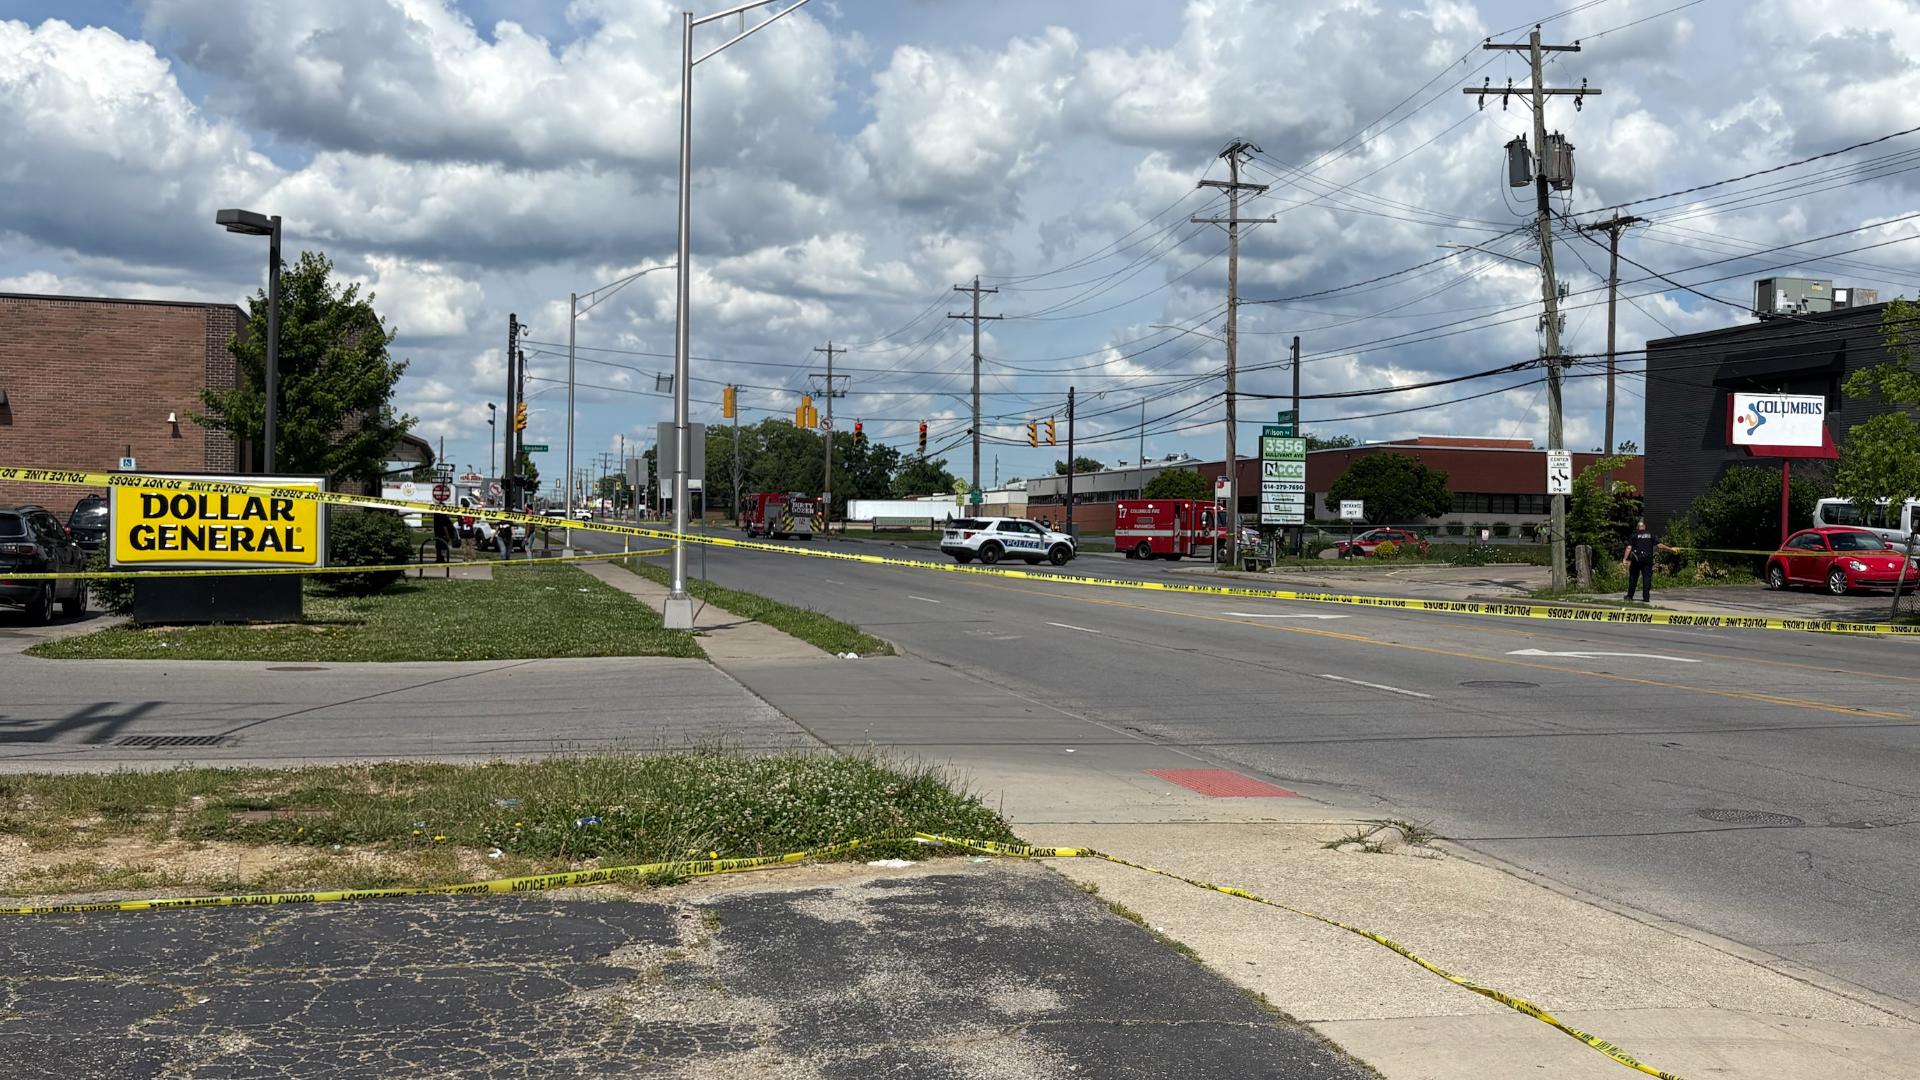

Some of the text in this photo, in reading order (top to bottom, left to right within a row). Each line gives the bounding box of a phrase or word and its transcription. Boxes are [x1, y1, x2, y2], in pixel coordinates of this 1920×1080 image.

[1756, 400, 1823, 414] COLUMBUS
[1265, 439, 1304, 452] 3556
[2, 468, 87, 483] POLICE LINE DO
[107, 475, 250, 495] POLICE LINE DO NOT CROSS
[270, 488, 302, 499] CROSS
[140, 492, 295, 522] DOLLAR
[428, 503, 562, 525] POLICE LINE DO NOT CROSS
[1119, 508, 1128, 519] 17
[129, 524, 305, 553] GENERAL
[1006, 539, 1037, 549] POLICE
[1423, 601, 1531, 616] POLICE LINE DO NOT CROSS
[1547, 608, 1653, 623] POLICE LINE DO NOT CROSS
[1668, 614, 1768, 628] POLICE LINE DO NOT CROSS
[1782, 619, 1805, 629] CROSS
[1806, 620, 1821, 630] NOT
[1821, 621, 1832, 631] DO
[968, 838, 988, 849] LINE
[1008, 844, 1027, 855] NOT
[1028, 847, 1057, 857] CROSS
